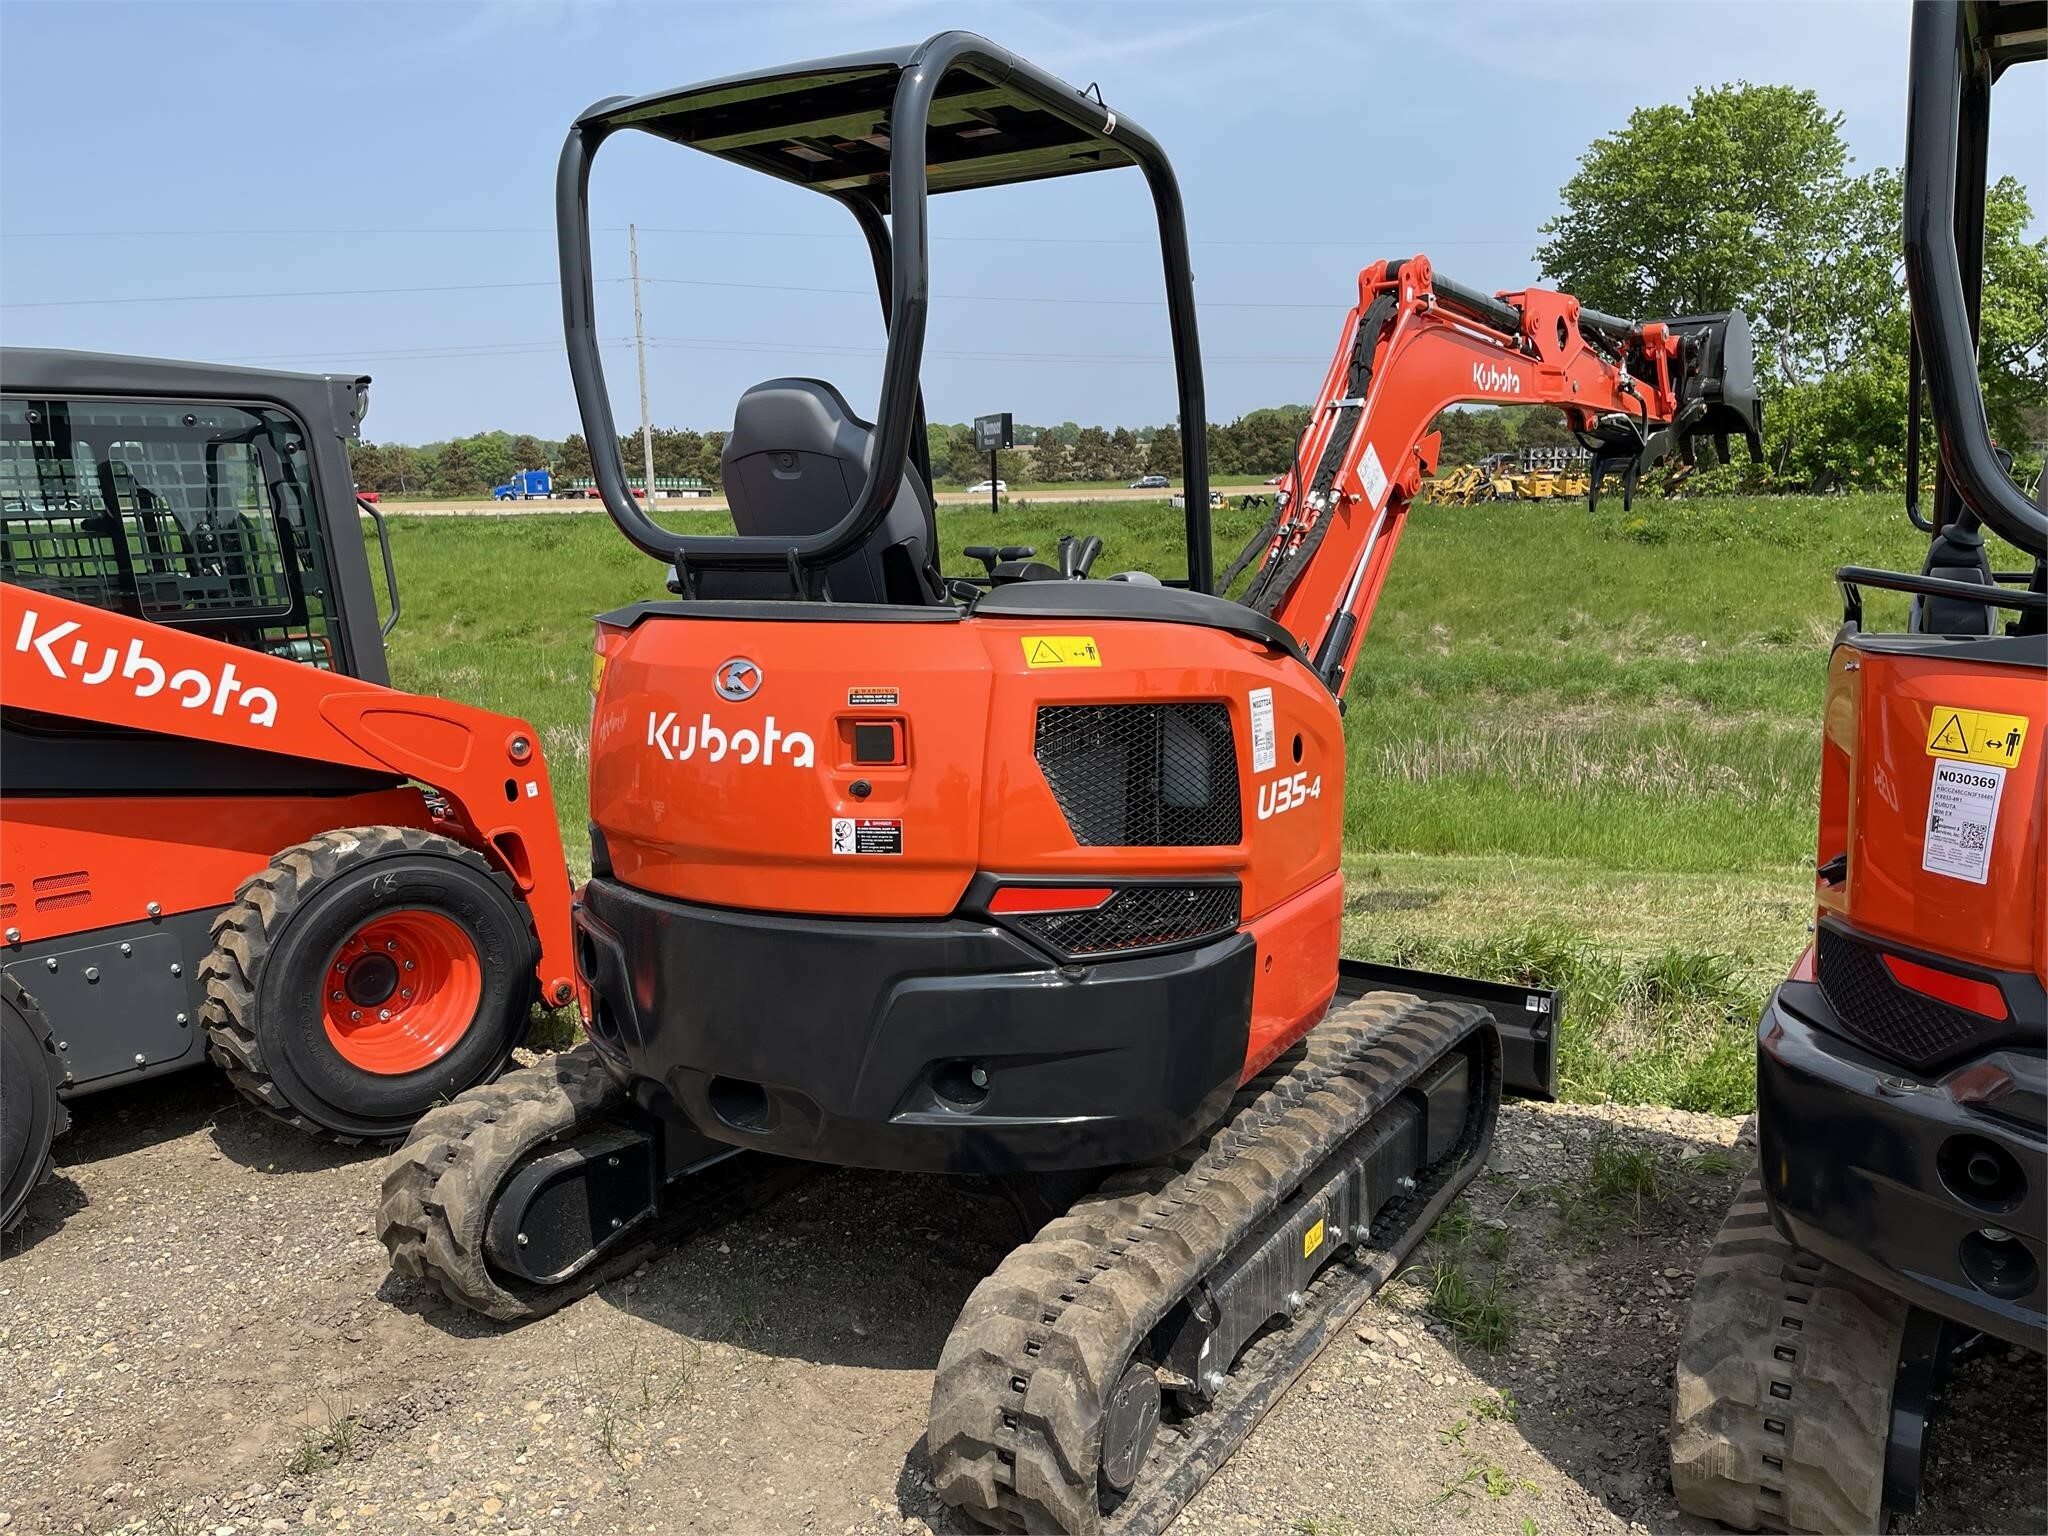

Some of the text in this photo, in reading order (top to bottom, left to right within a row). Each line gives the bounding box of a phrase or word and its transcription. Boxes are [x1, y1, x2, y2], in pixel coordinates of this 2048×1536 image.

[1473, 362, 1520, 394] Kubota
[15, 609, 278, 728] Kubota
[647, 711, 815, 768] Kubota
[1257, 771, 1321, 820] U35-4
[1939, 770, 1996, 789] N030369
